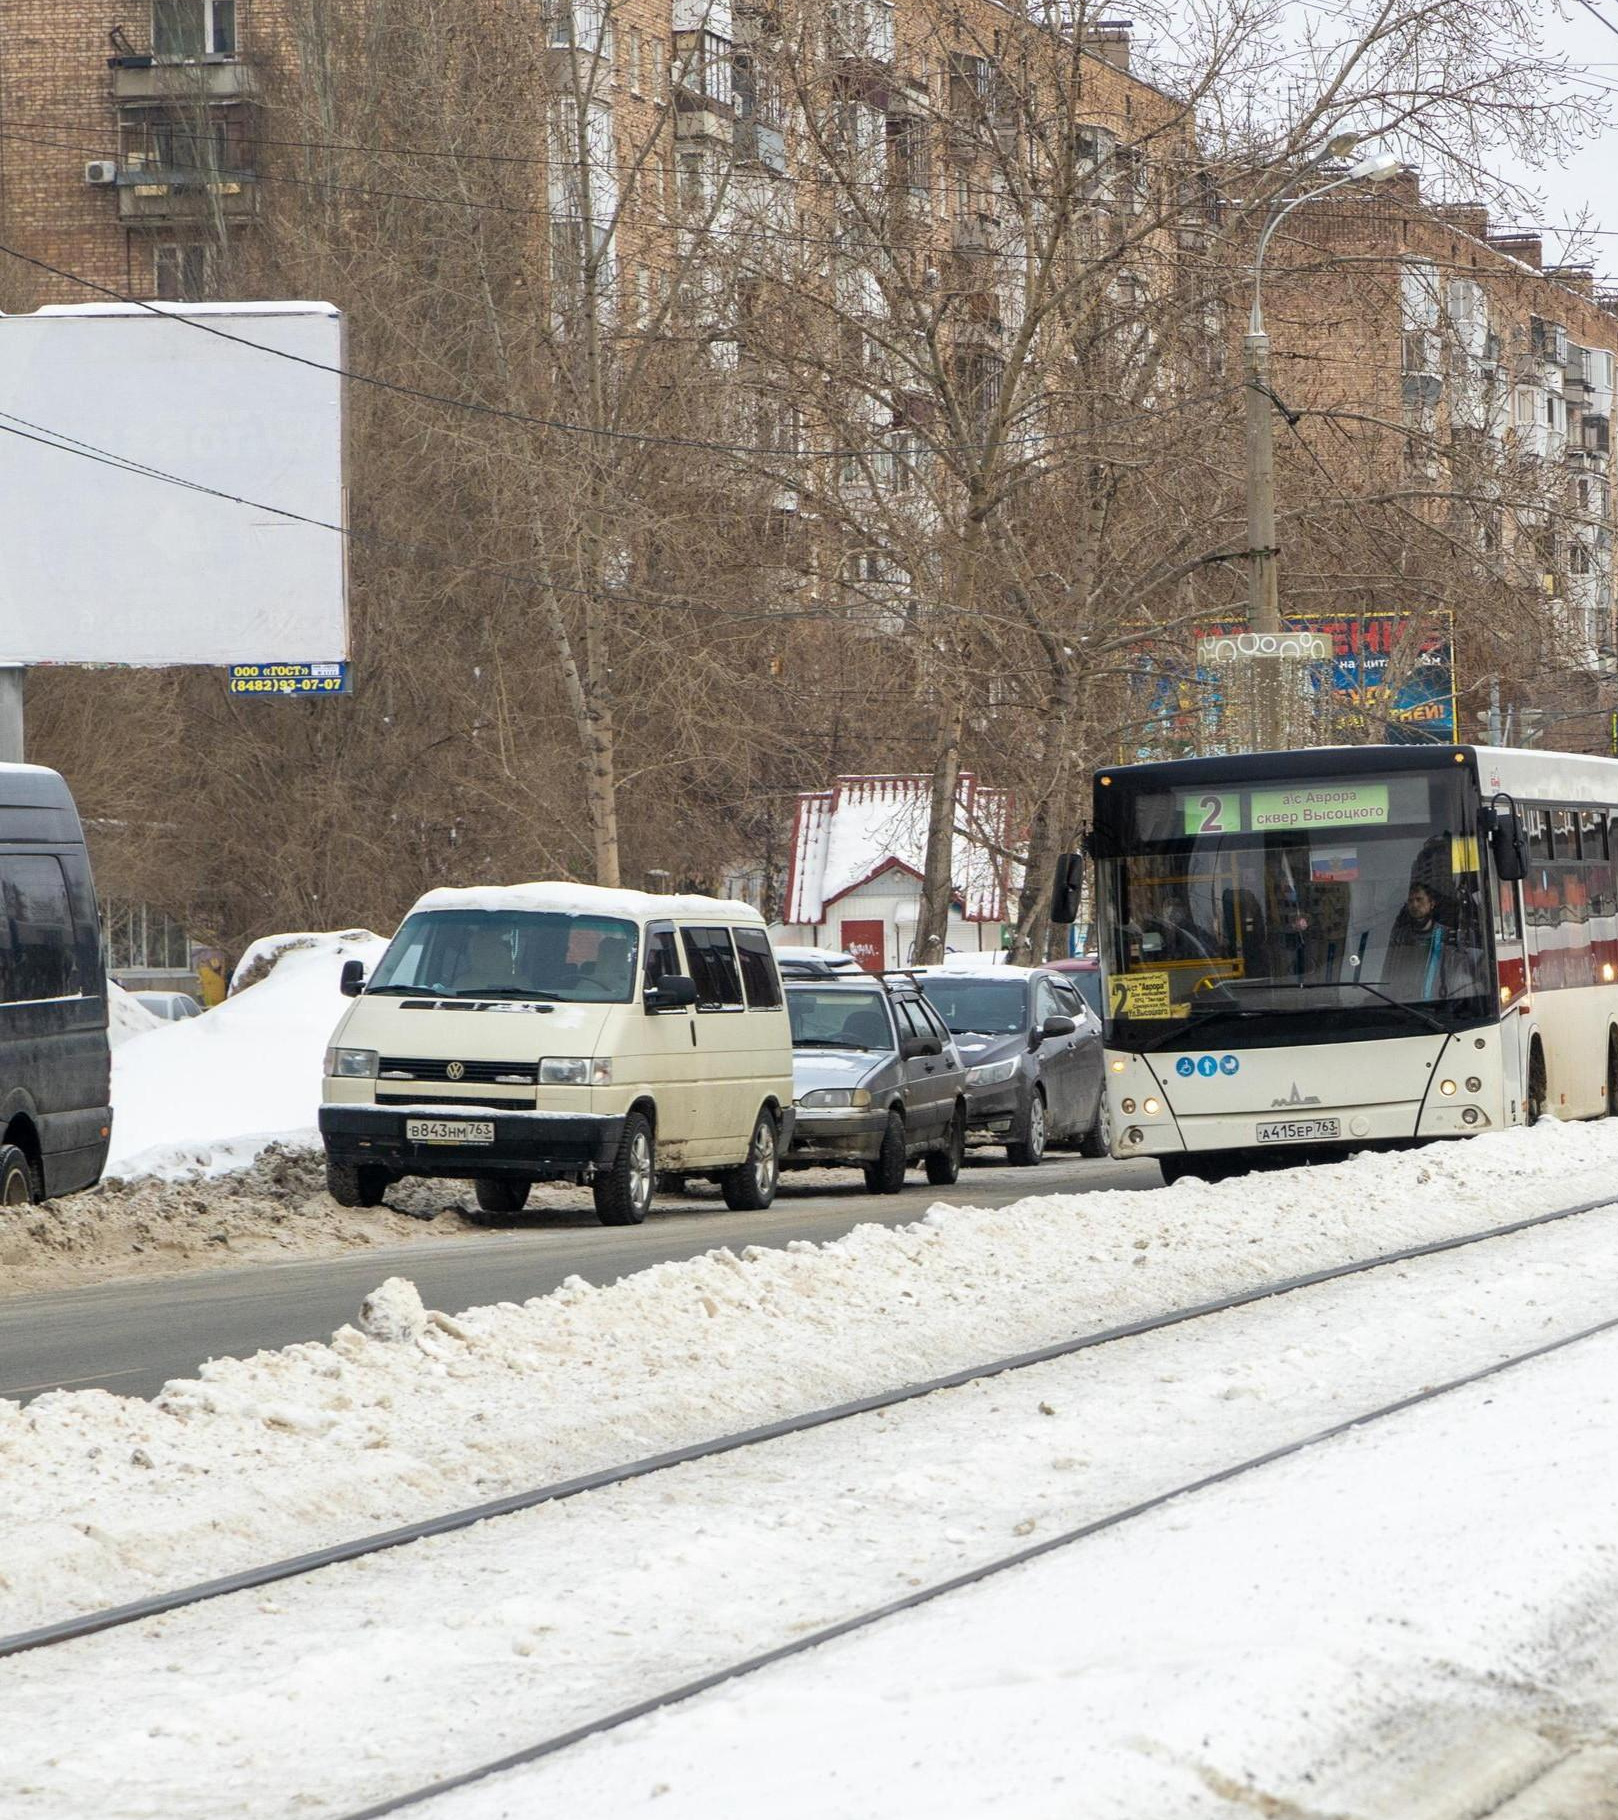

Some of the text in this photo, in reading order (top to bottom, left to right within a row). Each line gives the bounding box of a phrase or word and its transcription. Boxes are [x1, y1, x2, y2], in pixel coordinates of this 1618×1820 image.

[230, 679, 341, 692] (8482)93-07-07
[1306, 790, 1357, 804] Аврора
[1199, 796, 1223, 832] 2
[1256, 805, 1385, 825] сквер Высоцкого
[468, 1123, 491, 1135] 763
[1263, 1121, 1335, 1139] А415ЕР 763
